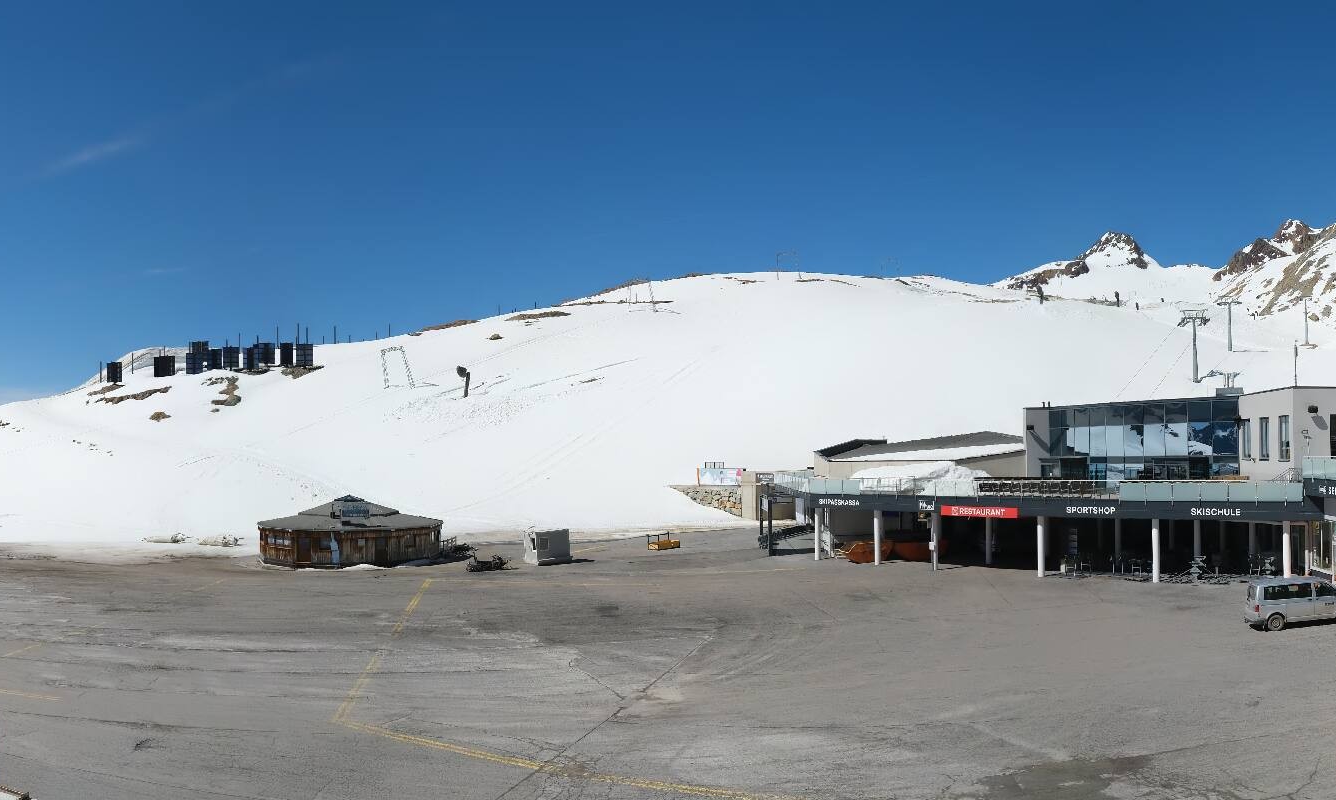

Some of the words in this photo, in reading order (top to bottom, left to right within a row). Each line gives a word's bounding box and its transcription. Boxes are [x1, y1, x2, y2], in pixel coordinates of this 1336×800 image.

[818, 498, 860, 506] SKIPASSKASSA
[959, 507, 1006, 516] RESTAURANT
[1066, 506, 1116, 515] SPORTSHOP
[1190, 507, 1241, 516] SKISCHULE
